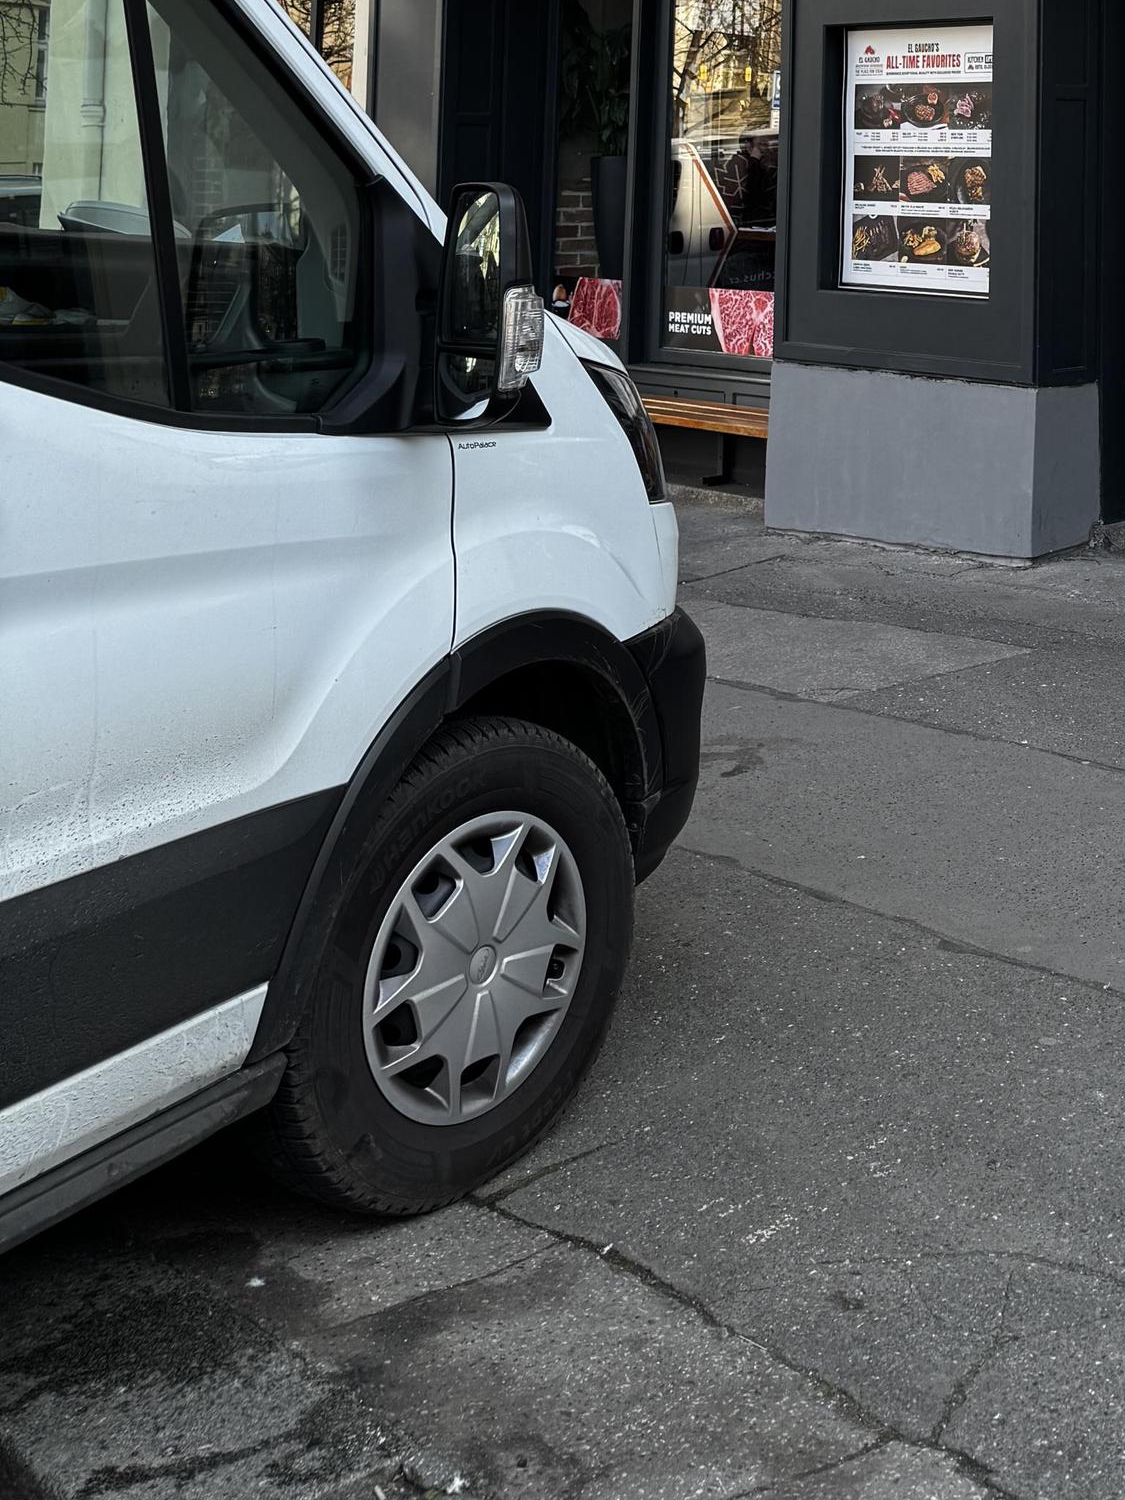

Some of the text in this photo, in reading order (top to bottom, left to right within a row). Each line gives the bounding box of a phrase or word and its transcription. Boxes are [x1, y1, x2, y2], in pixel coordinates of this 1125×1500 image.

[886, 55, 920, 69] ALL-TIME
[922, 54, 961, 69] FAVORITES
[669, 311, 712, 324] PREMIUM
[669, 323, 712, 335] MEAT CUTS
